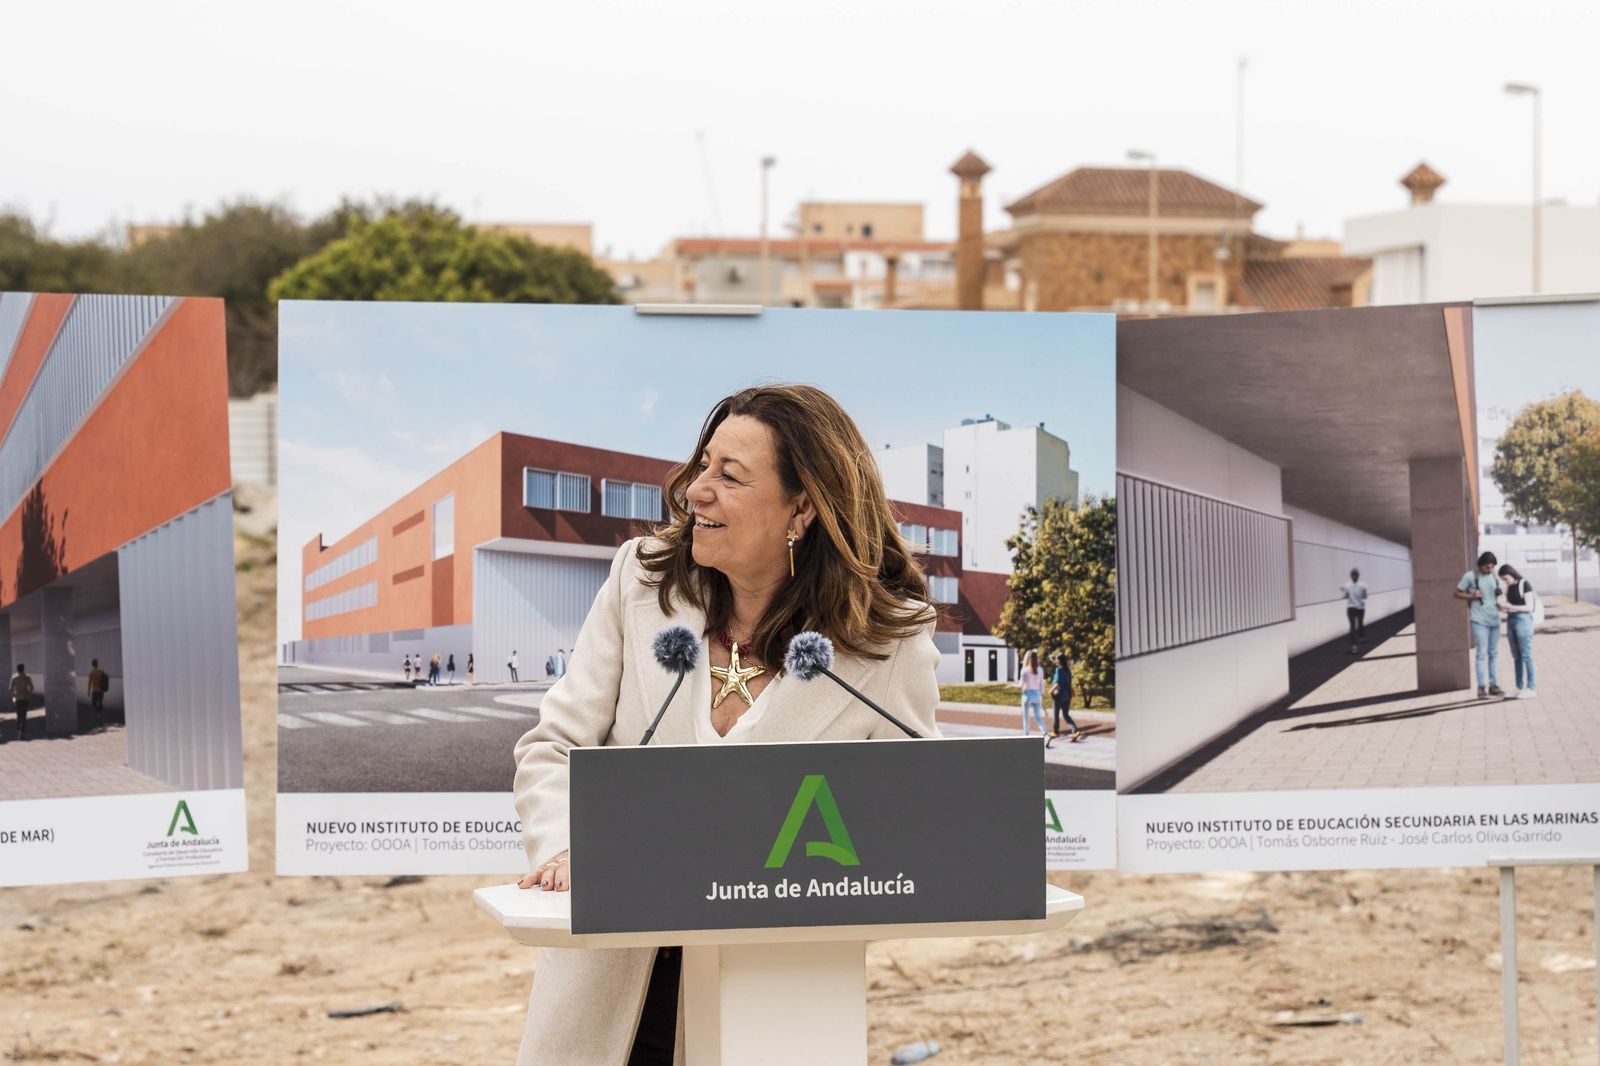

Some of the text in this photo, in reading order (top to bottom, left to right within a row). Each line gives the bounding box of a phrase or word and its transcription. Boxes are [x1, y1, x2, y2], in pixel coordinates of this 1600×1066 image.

[306, 821, 522, 834] NUEVO INSTITUTO DE EDUCAC
[1146, 812, 1599, 834] NUEVO INSTITUTO DE EDUCACIÓN SECUNDARIA EN LAS MARINAS
[0, 828, 54, 843] DE MAR)
[147, 841, 168, 849] Junta
[182, 836, 219, 846] Andalucía
[1146, 837, 1205, 852] Proyecto:
[1257, 835, 1298, 848] Tomás
[1302, 834, 1356, 847] Osborne
[1360, 833, 1387, 846] Ruiz
[1398, 832, 1428, 846] José
[1431, 831, 1473, 844] Carlos
[1476, 830, 1509, 843] Oliva
[1512, 829, 1562, 842] Garrido
[306, 838, 367, 854] Proyecto:
[423, 837, 465, 850] Tomás
[469, 837, 523, 850] Osborne
[705, 872, 915, 900] Junta de Andalucía
